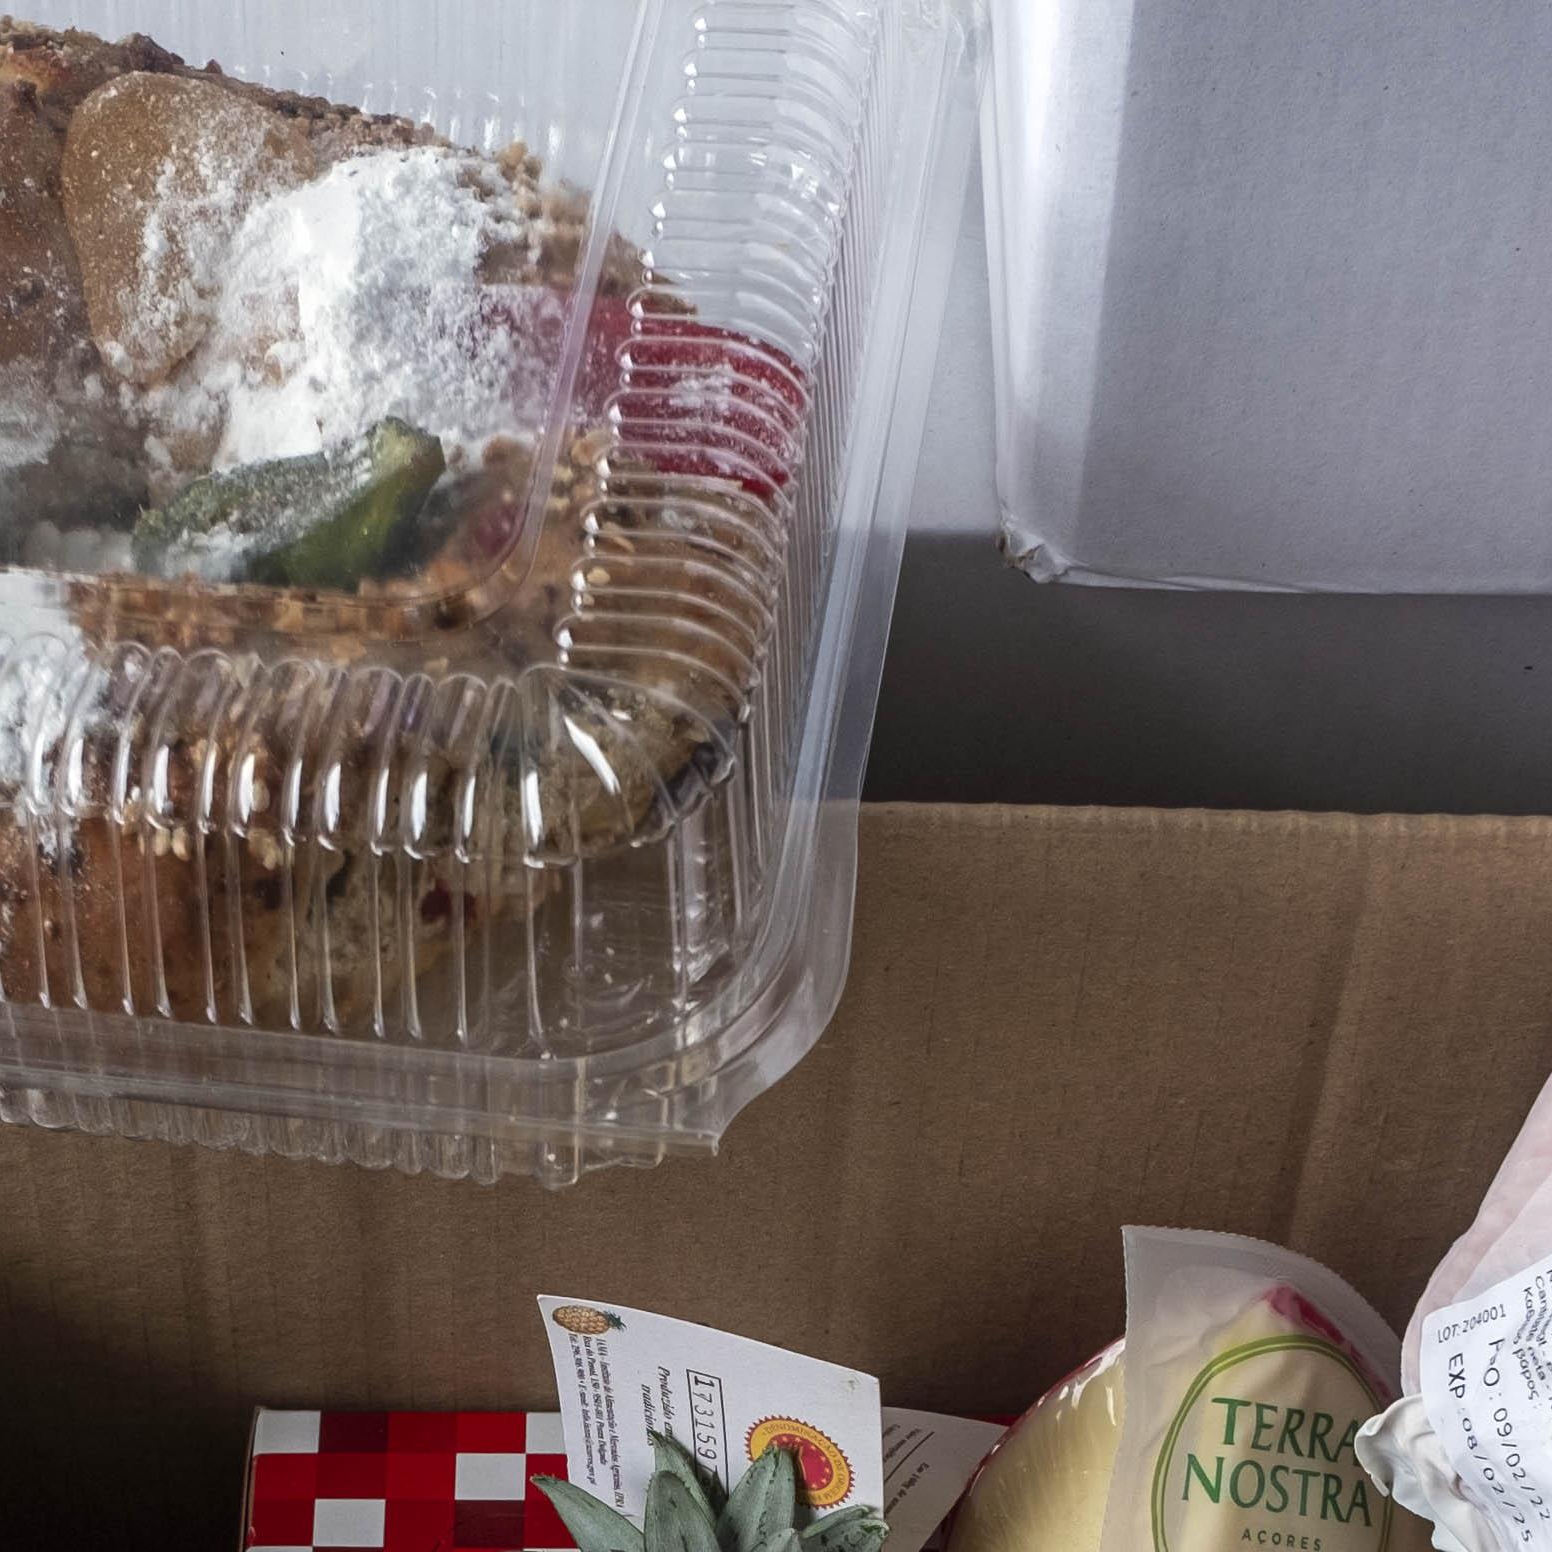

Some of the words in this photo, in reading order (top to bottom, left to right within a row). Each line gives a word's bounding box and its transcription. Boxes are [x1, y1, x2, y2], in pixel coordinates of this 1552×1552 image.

[658, 1366, 676, 1420] Produzido
[1447, 1351, 1468, 1400] EXP
[641, 1383, 657, 1447] tradicionis
[1211, 1397, 1361, 1463] TERRA
[1180, 1453, 1375, 1529] NOSTRA
[1494, 1408, 1552, 1522] 09/02/22
[1241, 1527, 1323, 1552] AÇORES
